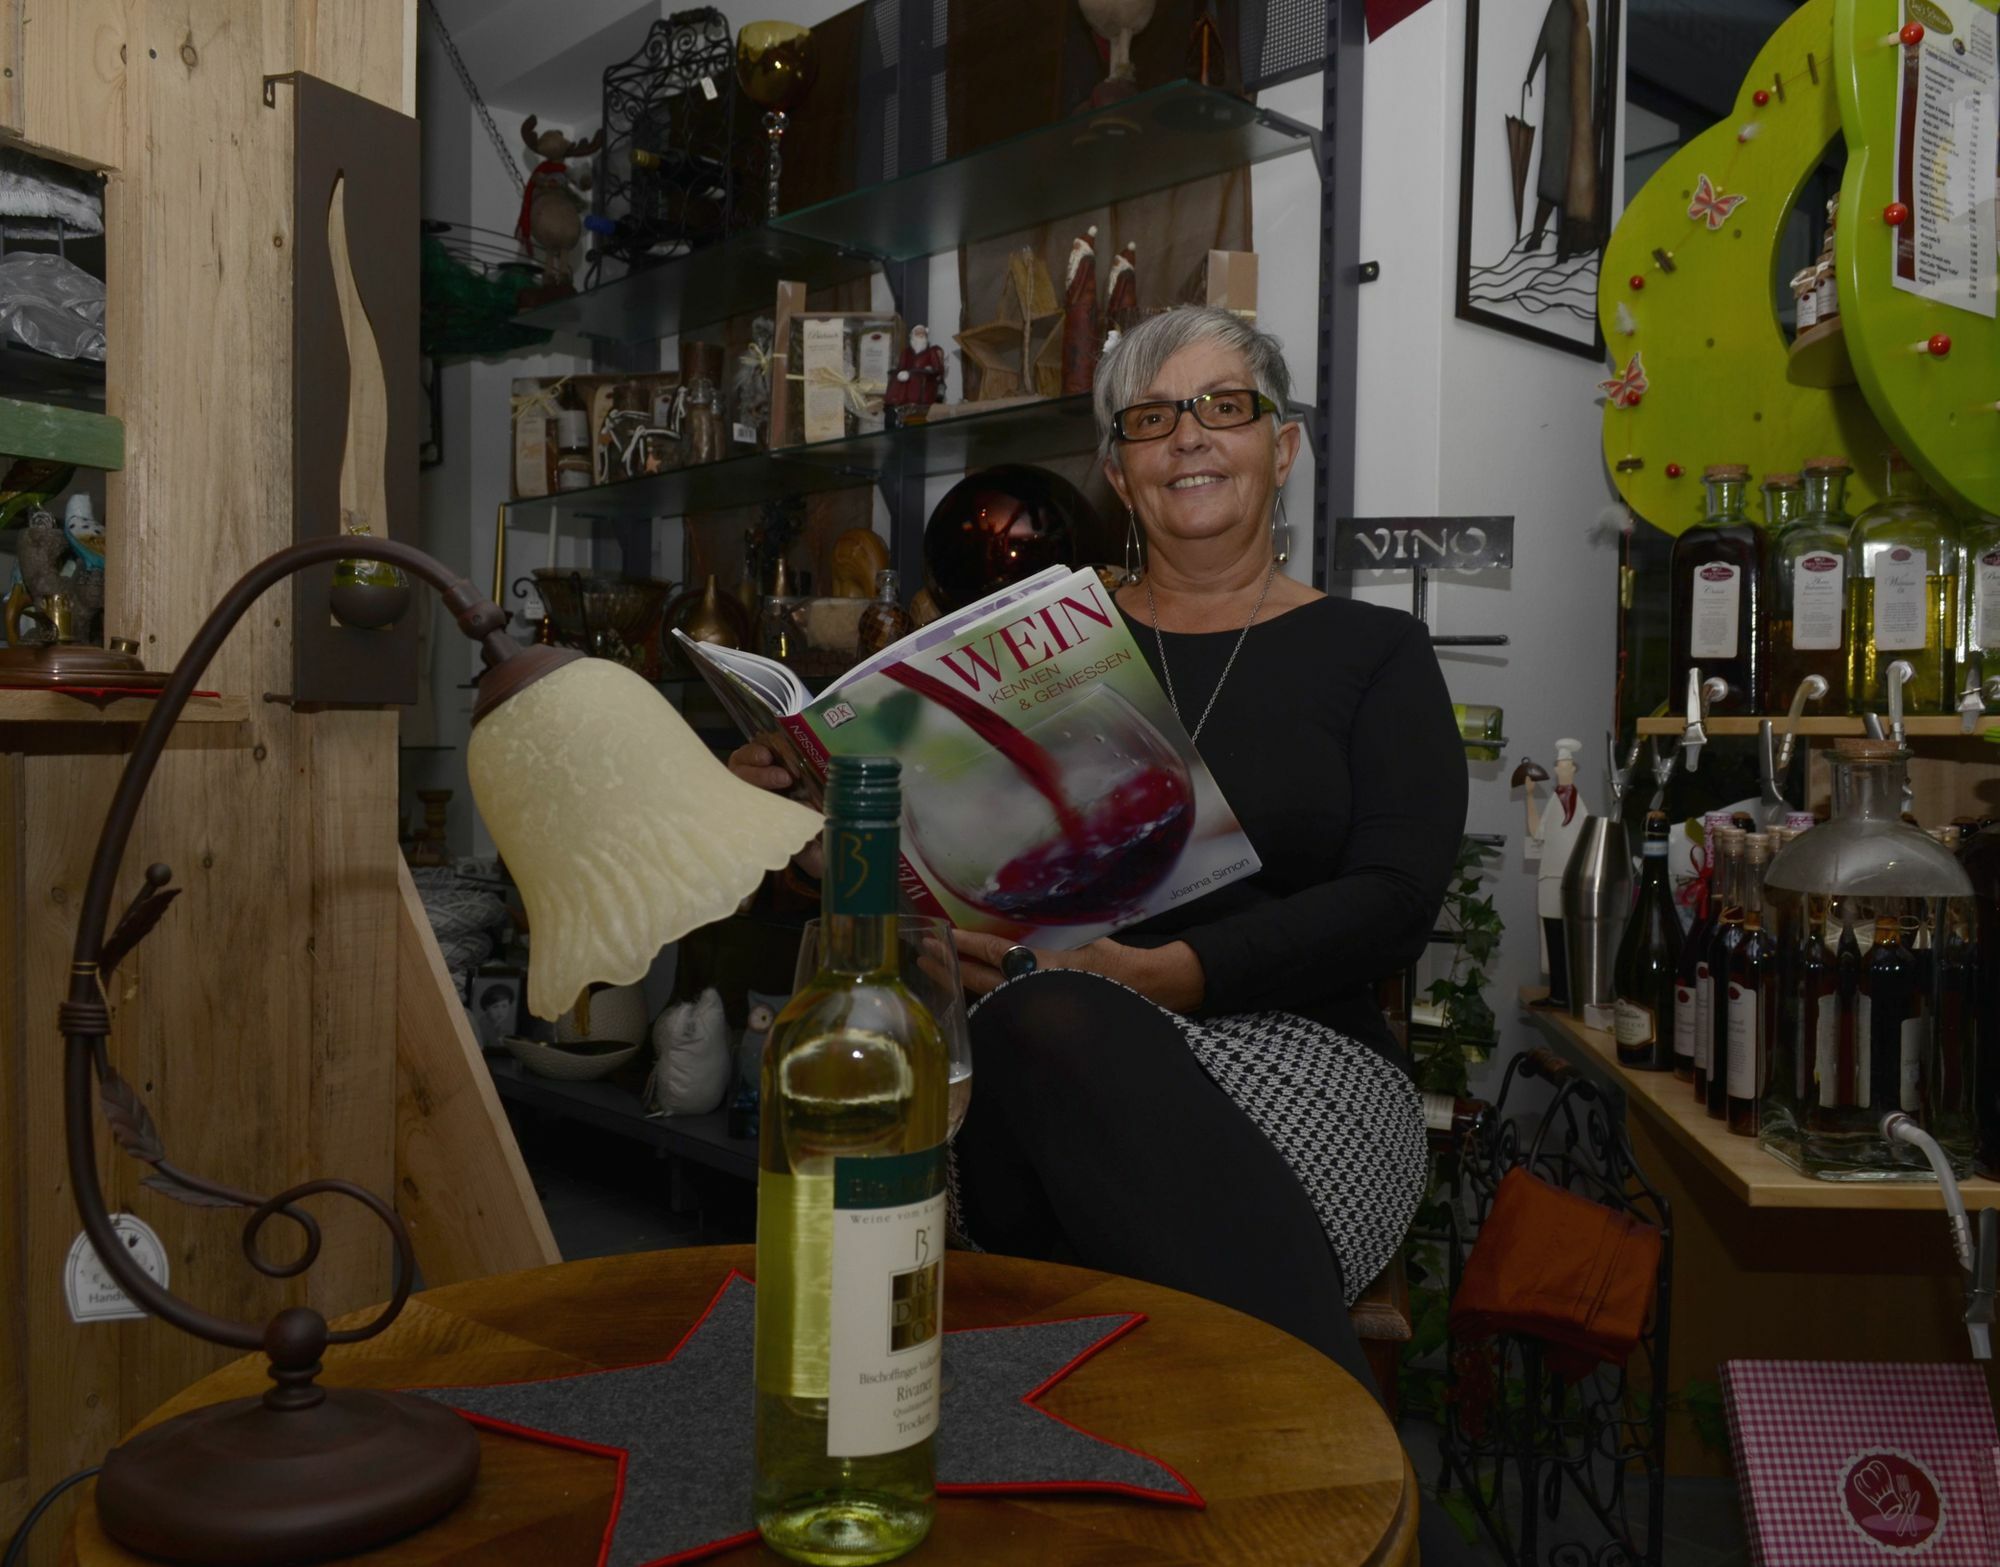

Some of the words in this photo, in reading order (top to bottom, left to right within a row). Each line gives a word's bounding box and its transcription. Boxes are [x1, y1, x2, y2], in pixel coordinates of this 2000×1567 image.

[1354, 527, 1487, 561] VINO
[936, 583, 1113, 693] WEIN
[988, 663, 1061, 705] KENNEN
[1019, 697, 1033, 711] &
[1034, 649, 1132, 705] GENIESSEN
[826, 702, 853, 726] DK
[790, 725, 829, 775] NIESSEN
[1169, 876, 1211, 900] Joanna
[1212, 858, 1250, 880] Simon
